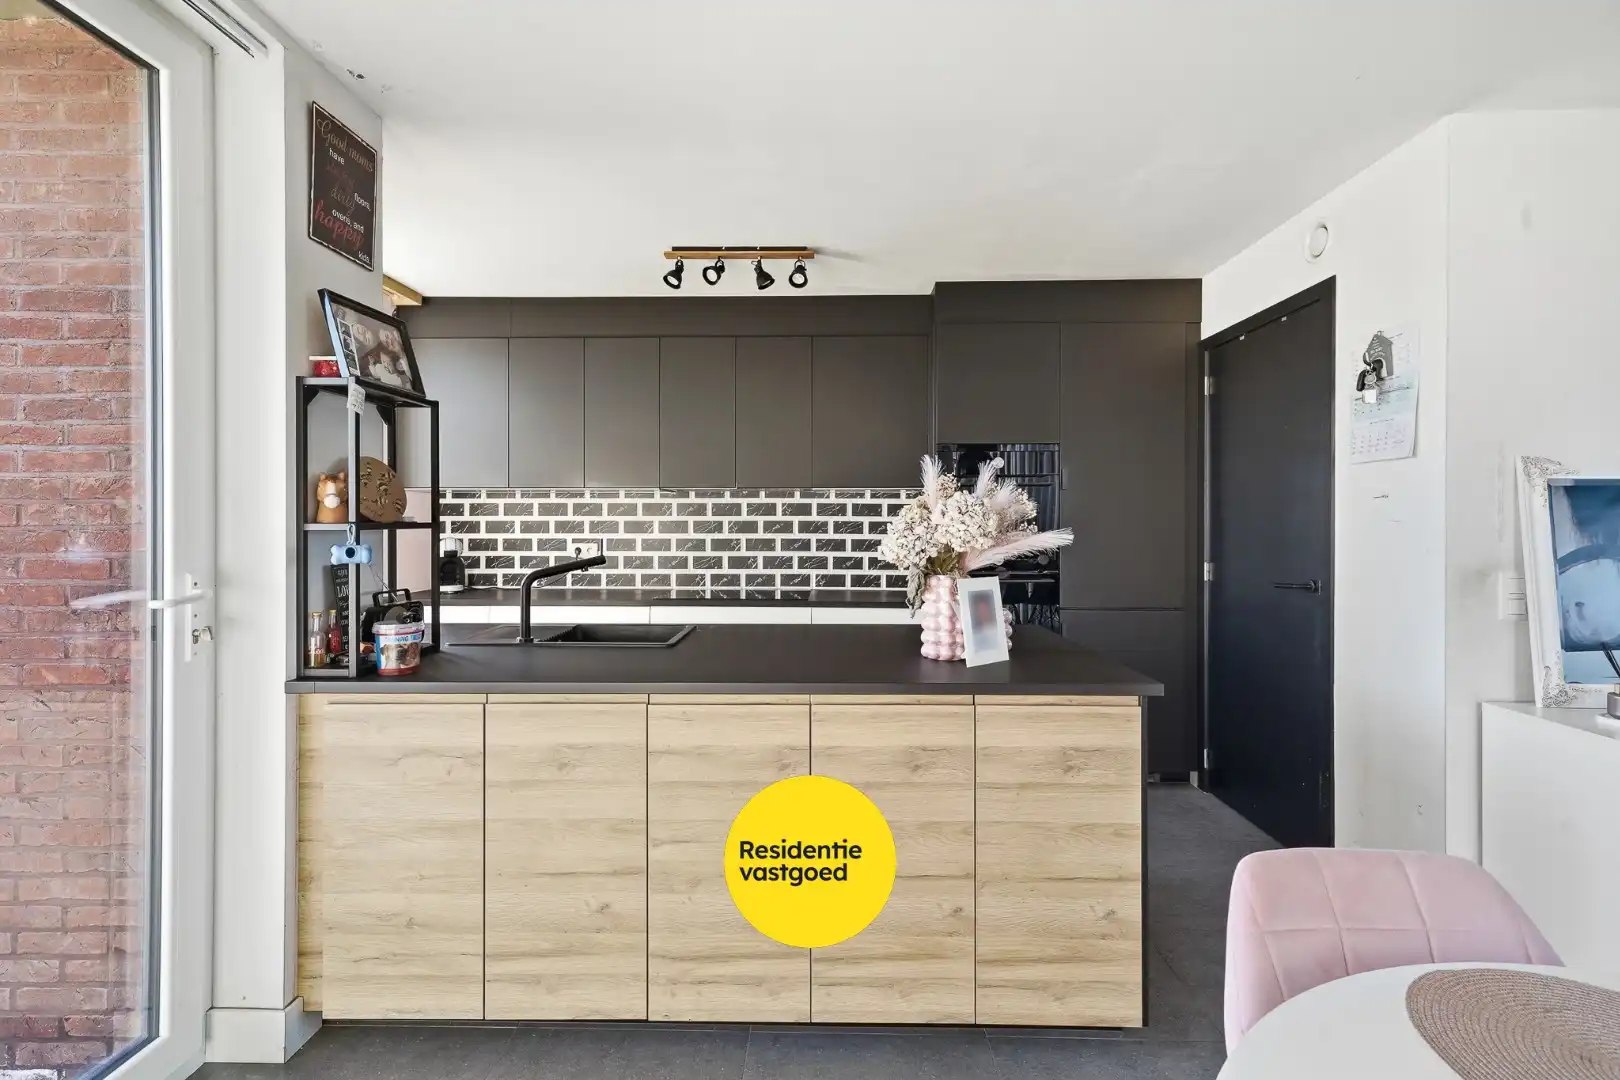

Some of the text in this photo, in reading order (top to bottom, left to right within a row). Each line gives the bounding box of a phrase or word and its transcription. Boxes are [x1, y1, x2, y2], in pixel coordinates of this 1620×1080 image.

[316, 118, 374, 172] Good moms
[329, 147, 345, 165] have
[314, 199, 365, 251] happy
[352, 221, 365, 234] and
